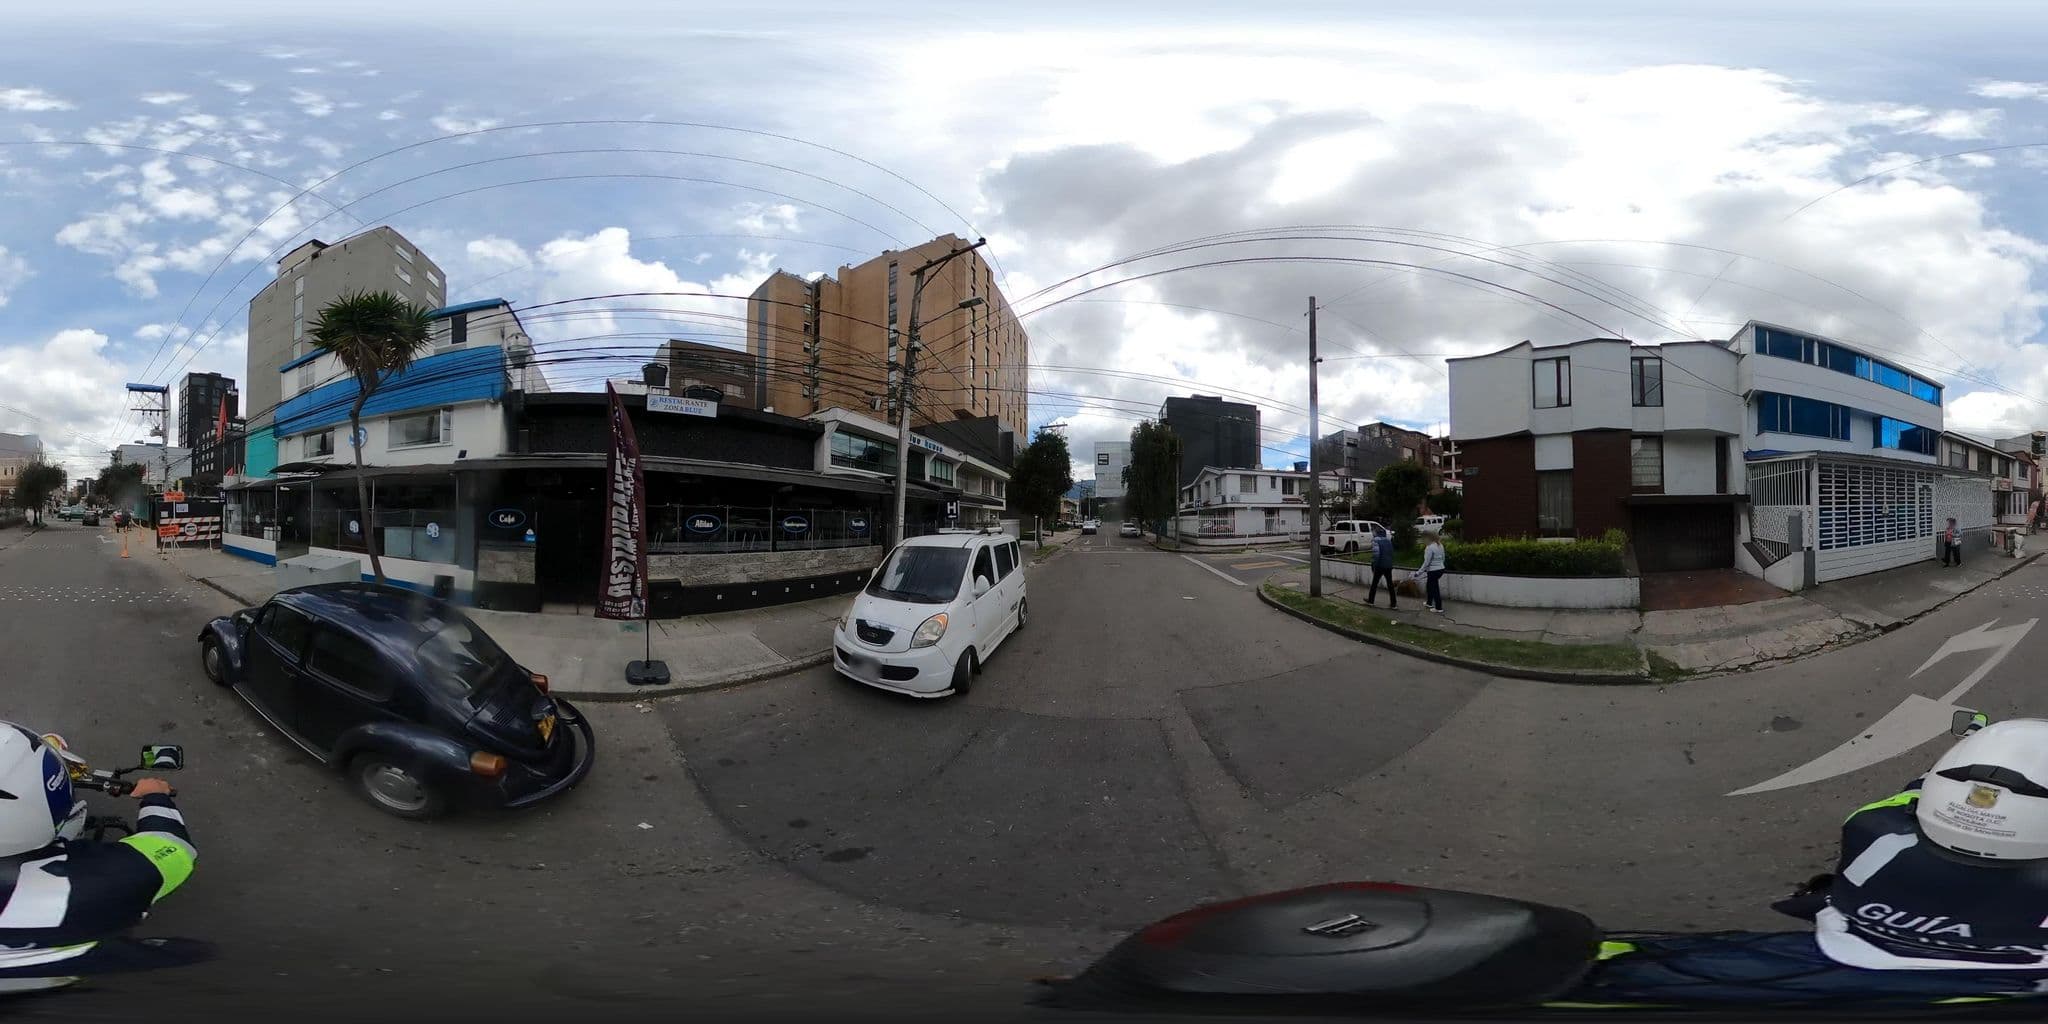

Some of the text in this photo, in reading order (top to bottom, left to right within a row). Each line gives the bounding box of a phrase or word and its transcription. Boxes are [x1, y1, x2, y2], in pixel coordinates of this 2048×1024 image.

[659, 397, 708, 408] RESTAURANTE
[947, 502, 957, 514] H
[1856, 903, 1972, 938] GUÍA
